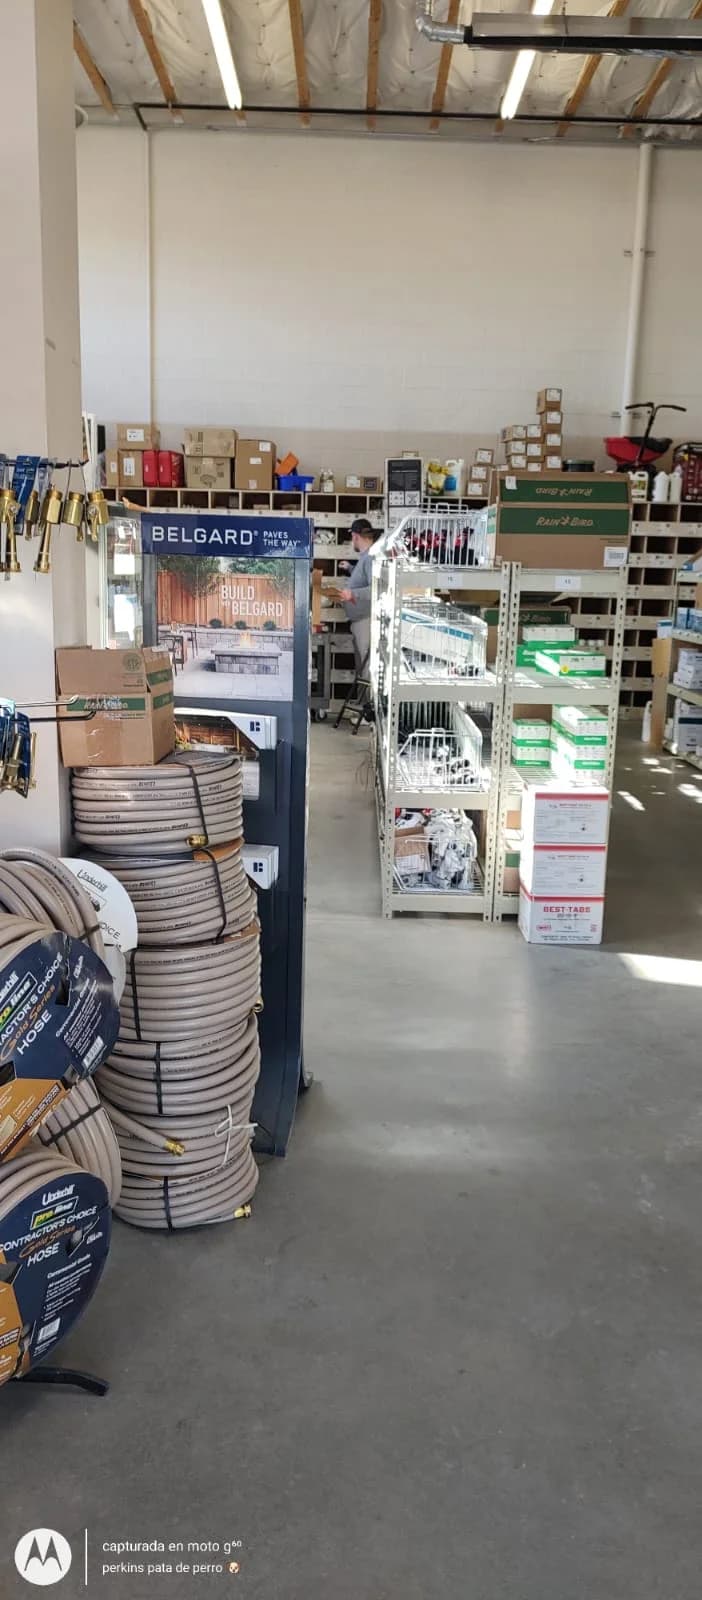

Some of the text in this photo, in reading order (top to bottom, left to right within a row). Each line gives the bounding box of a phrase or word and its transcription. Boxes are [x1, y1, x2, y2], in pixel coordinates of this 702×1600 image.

[536, 517, 594, 527] RAIN BIRD
[263, 531, 288, 539] PAVES
[263, 539, 279, 547] THE
[221, 585, 255, 601] BUILD
[231, 601, 283, 617] BELGARD
[37, 951, 63, 994] CHOICE
[16, 1009, 52, 1055] HOSE
[66, 1205, 98, 1224] CHOICE
[27, 1242, 60, 1267] HOSE
